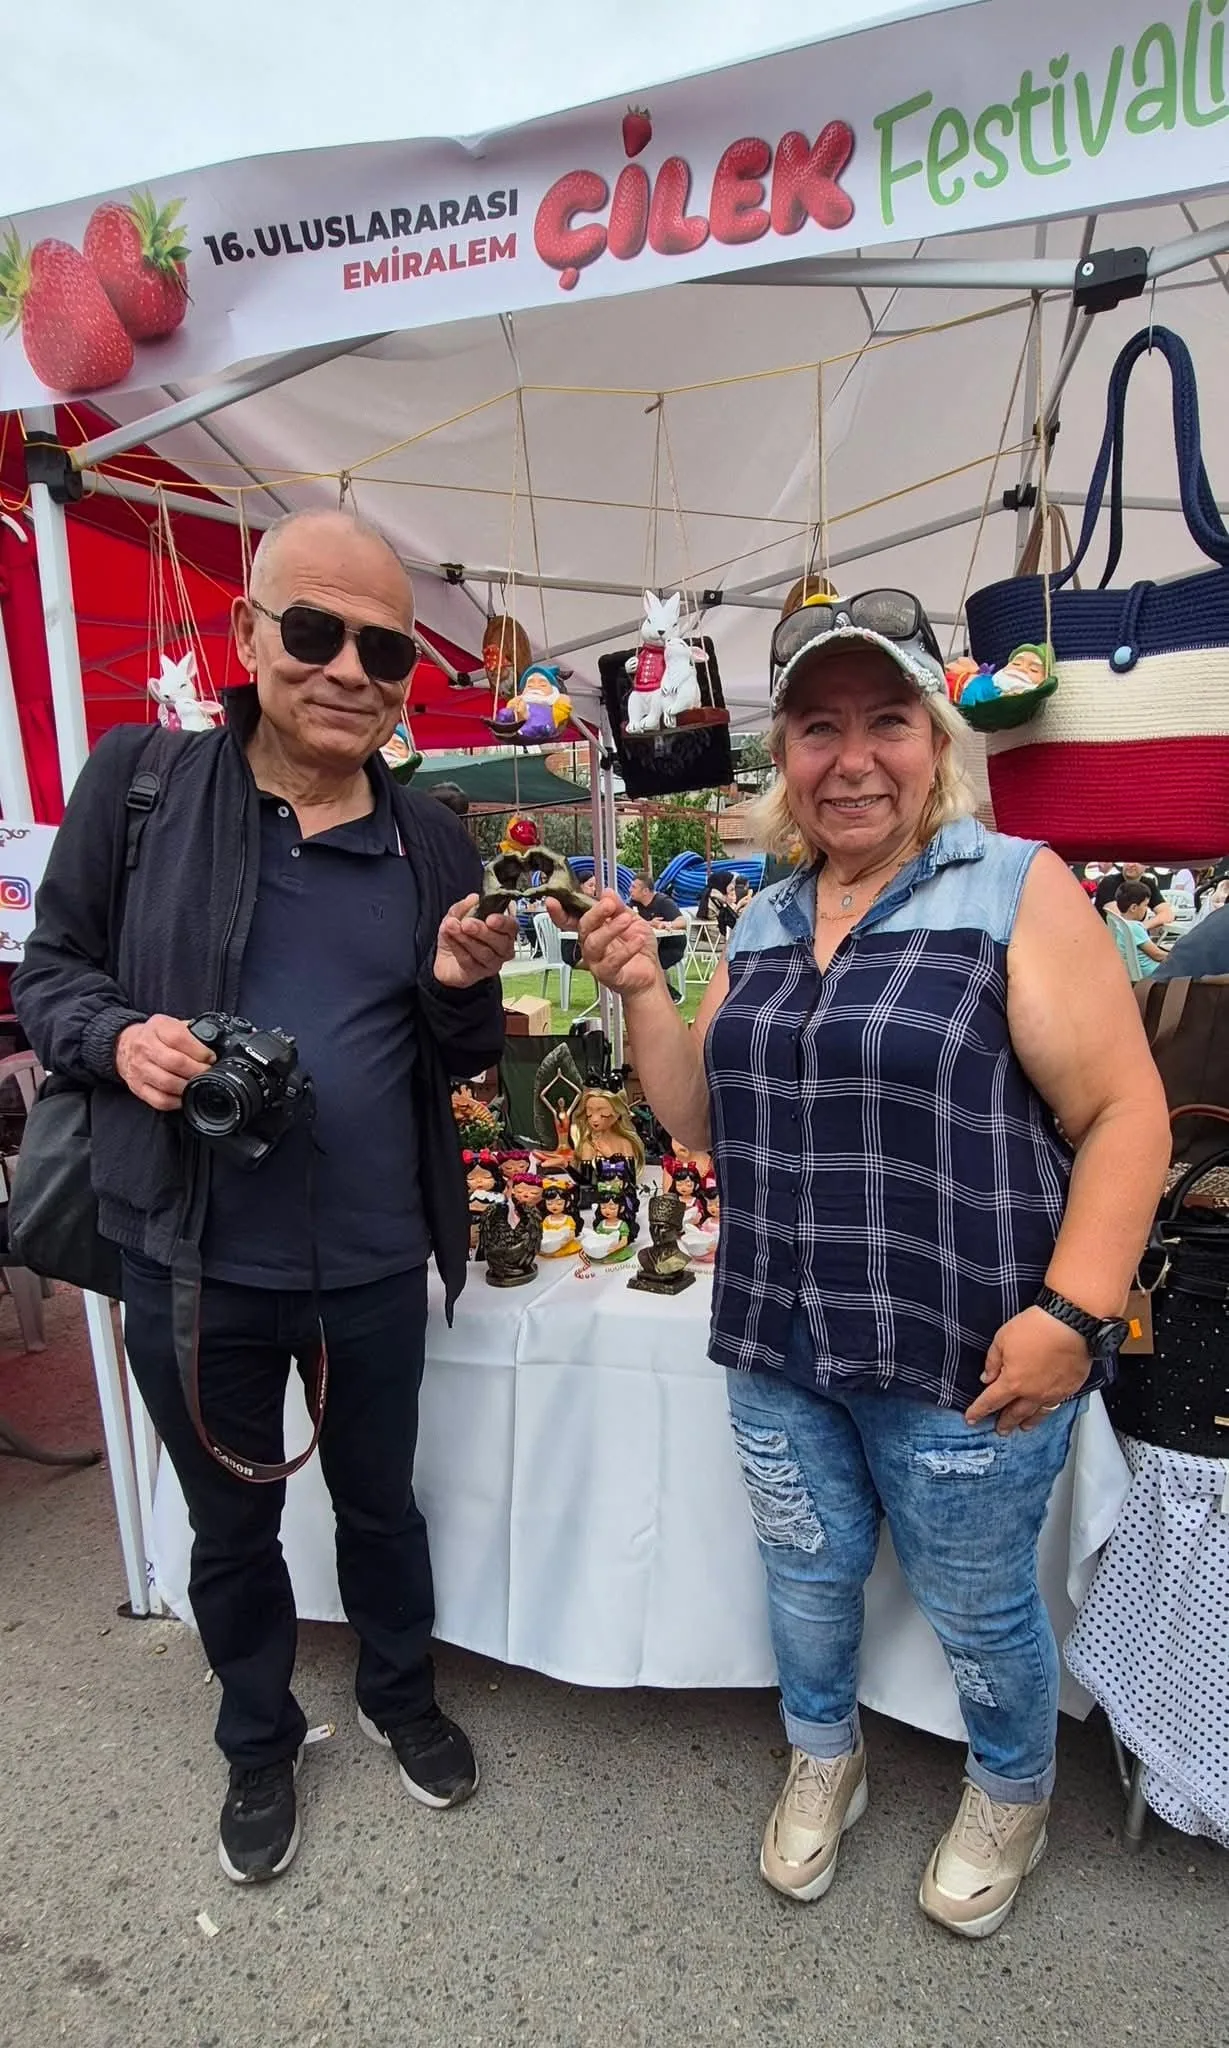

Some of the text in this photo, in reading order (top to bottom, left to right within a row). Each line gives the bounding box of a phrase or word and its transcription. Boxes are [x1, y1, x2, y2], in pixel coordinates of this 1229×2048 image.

[533, 0, 1229, 291] ÇİLEK Festivali
[203, 188, 518, 265] 16.ULUSLARARASI
[343, 233, 517, 290] EMİRALEM
[245, 1046, 269, 1065] Canon
